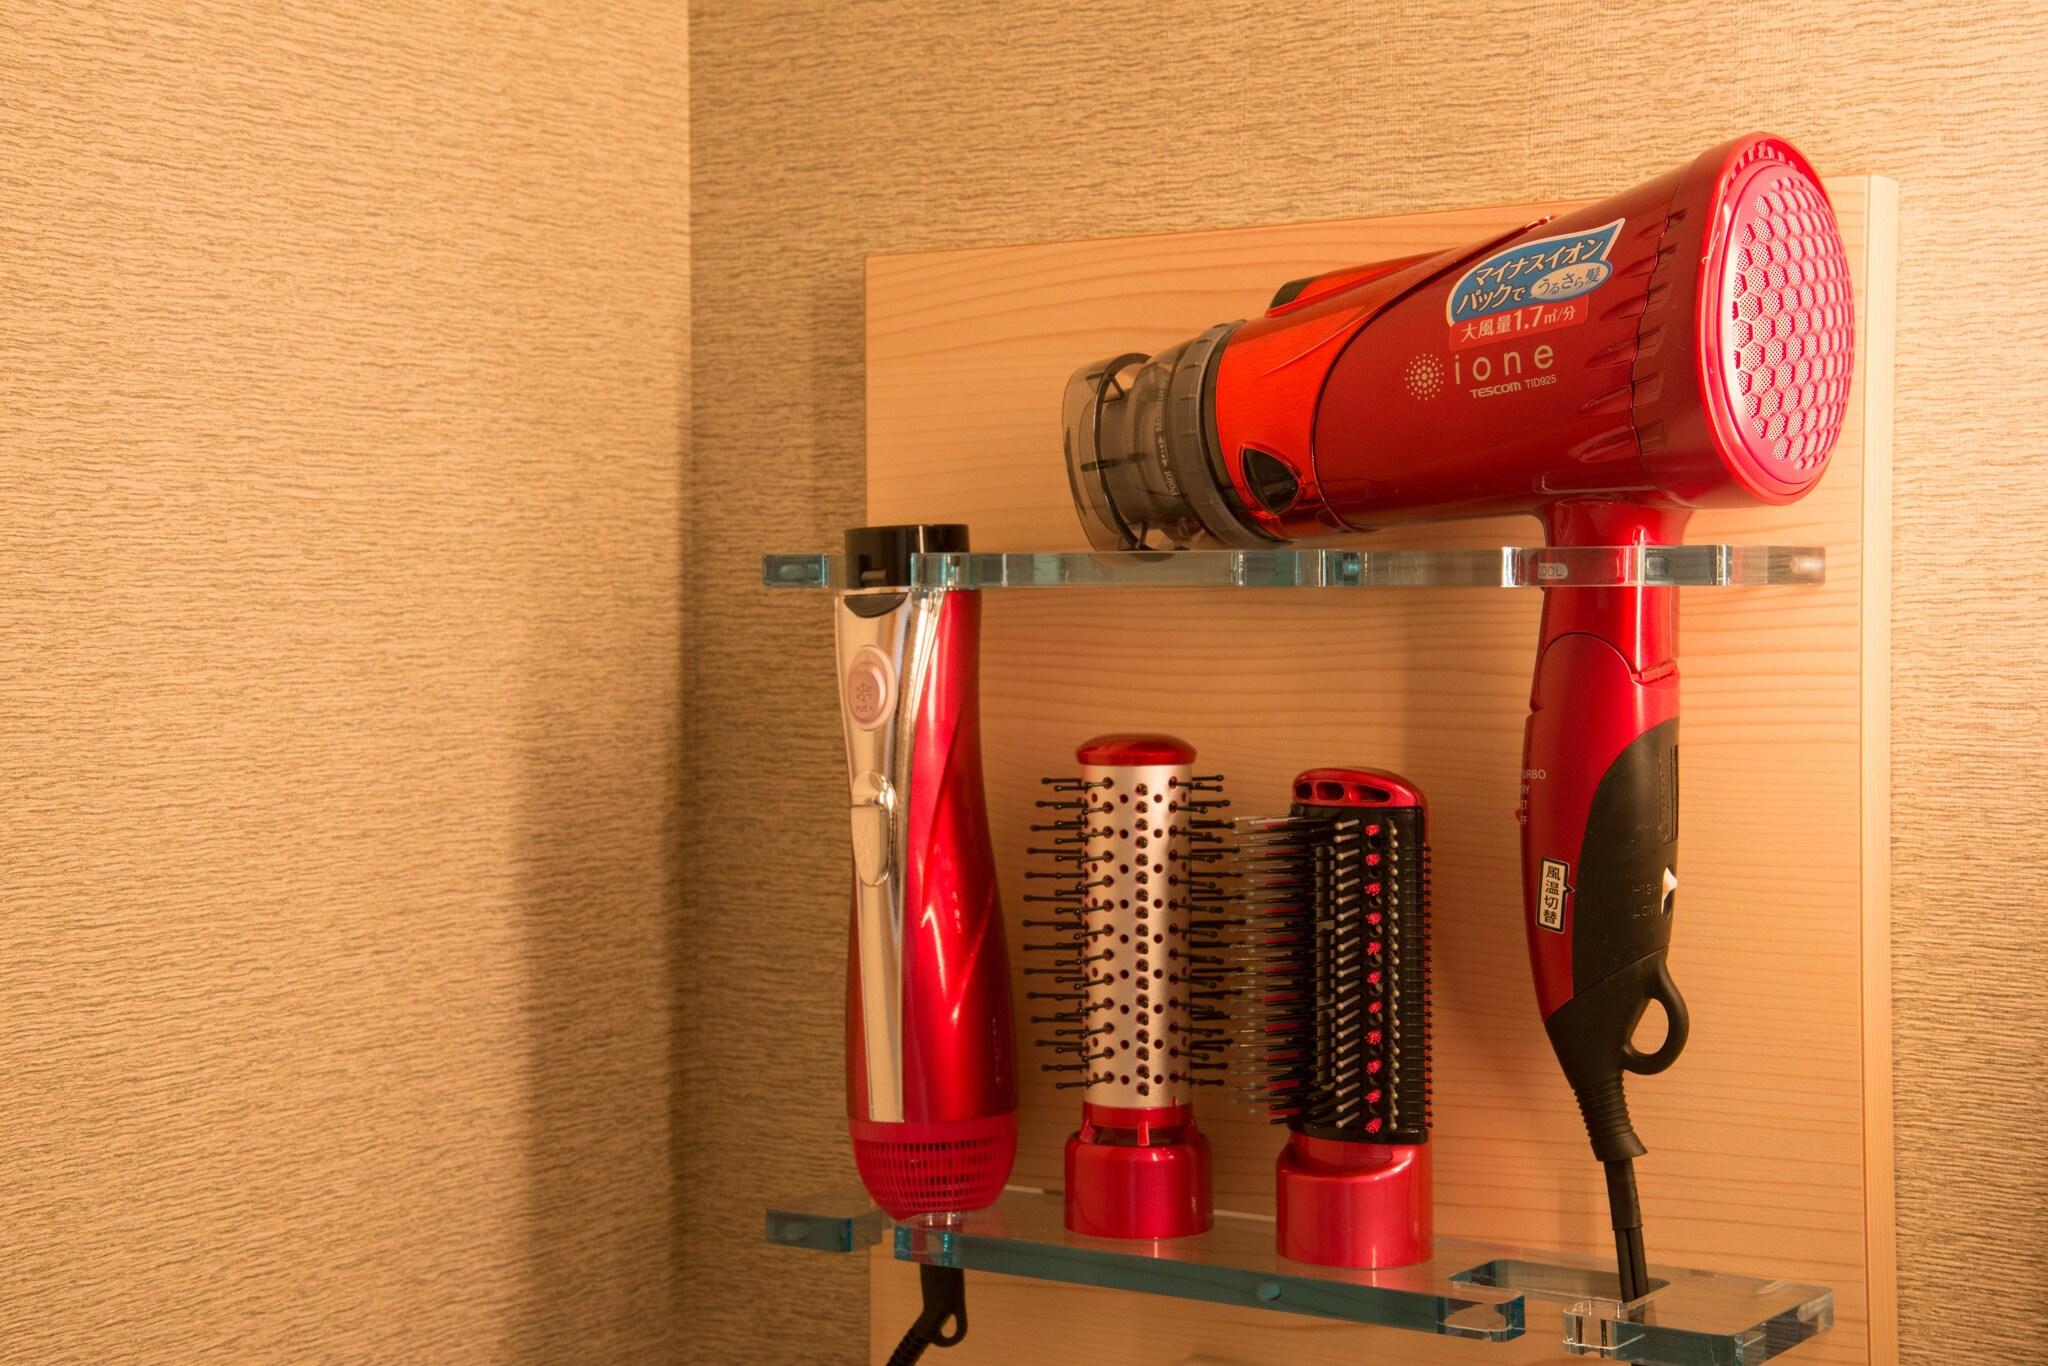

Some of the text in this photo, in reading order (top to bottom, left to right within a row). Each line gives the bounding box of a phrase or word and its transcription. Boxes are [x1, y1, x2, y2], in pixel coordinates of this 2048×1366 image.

[1476, 238, 1604, 286] マイナスイオン
[1456, 283, 1526, 315] パックで
[1539, 266, 1601, 296] うるさら髪
[1454, 344, 1553, 385] ione
[1470, 374, 1558, 399] TESCOM TID925
[1543, 865, 1561, 924] 風温切替
